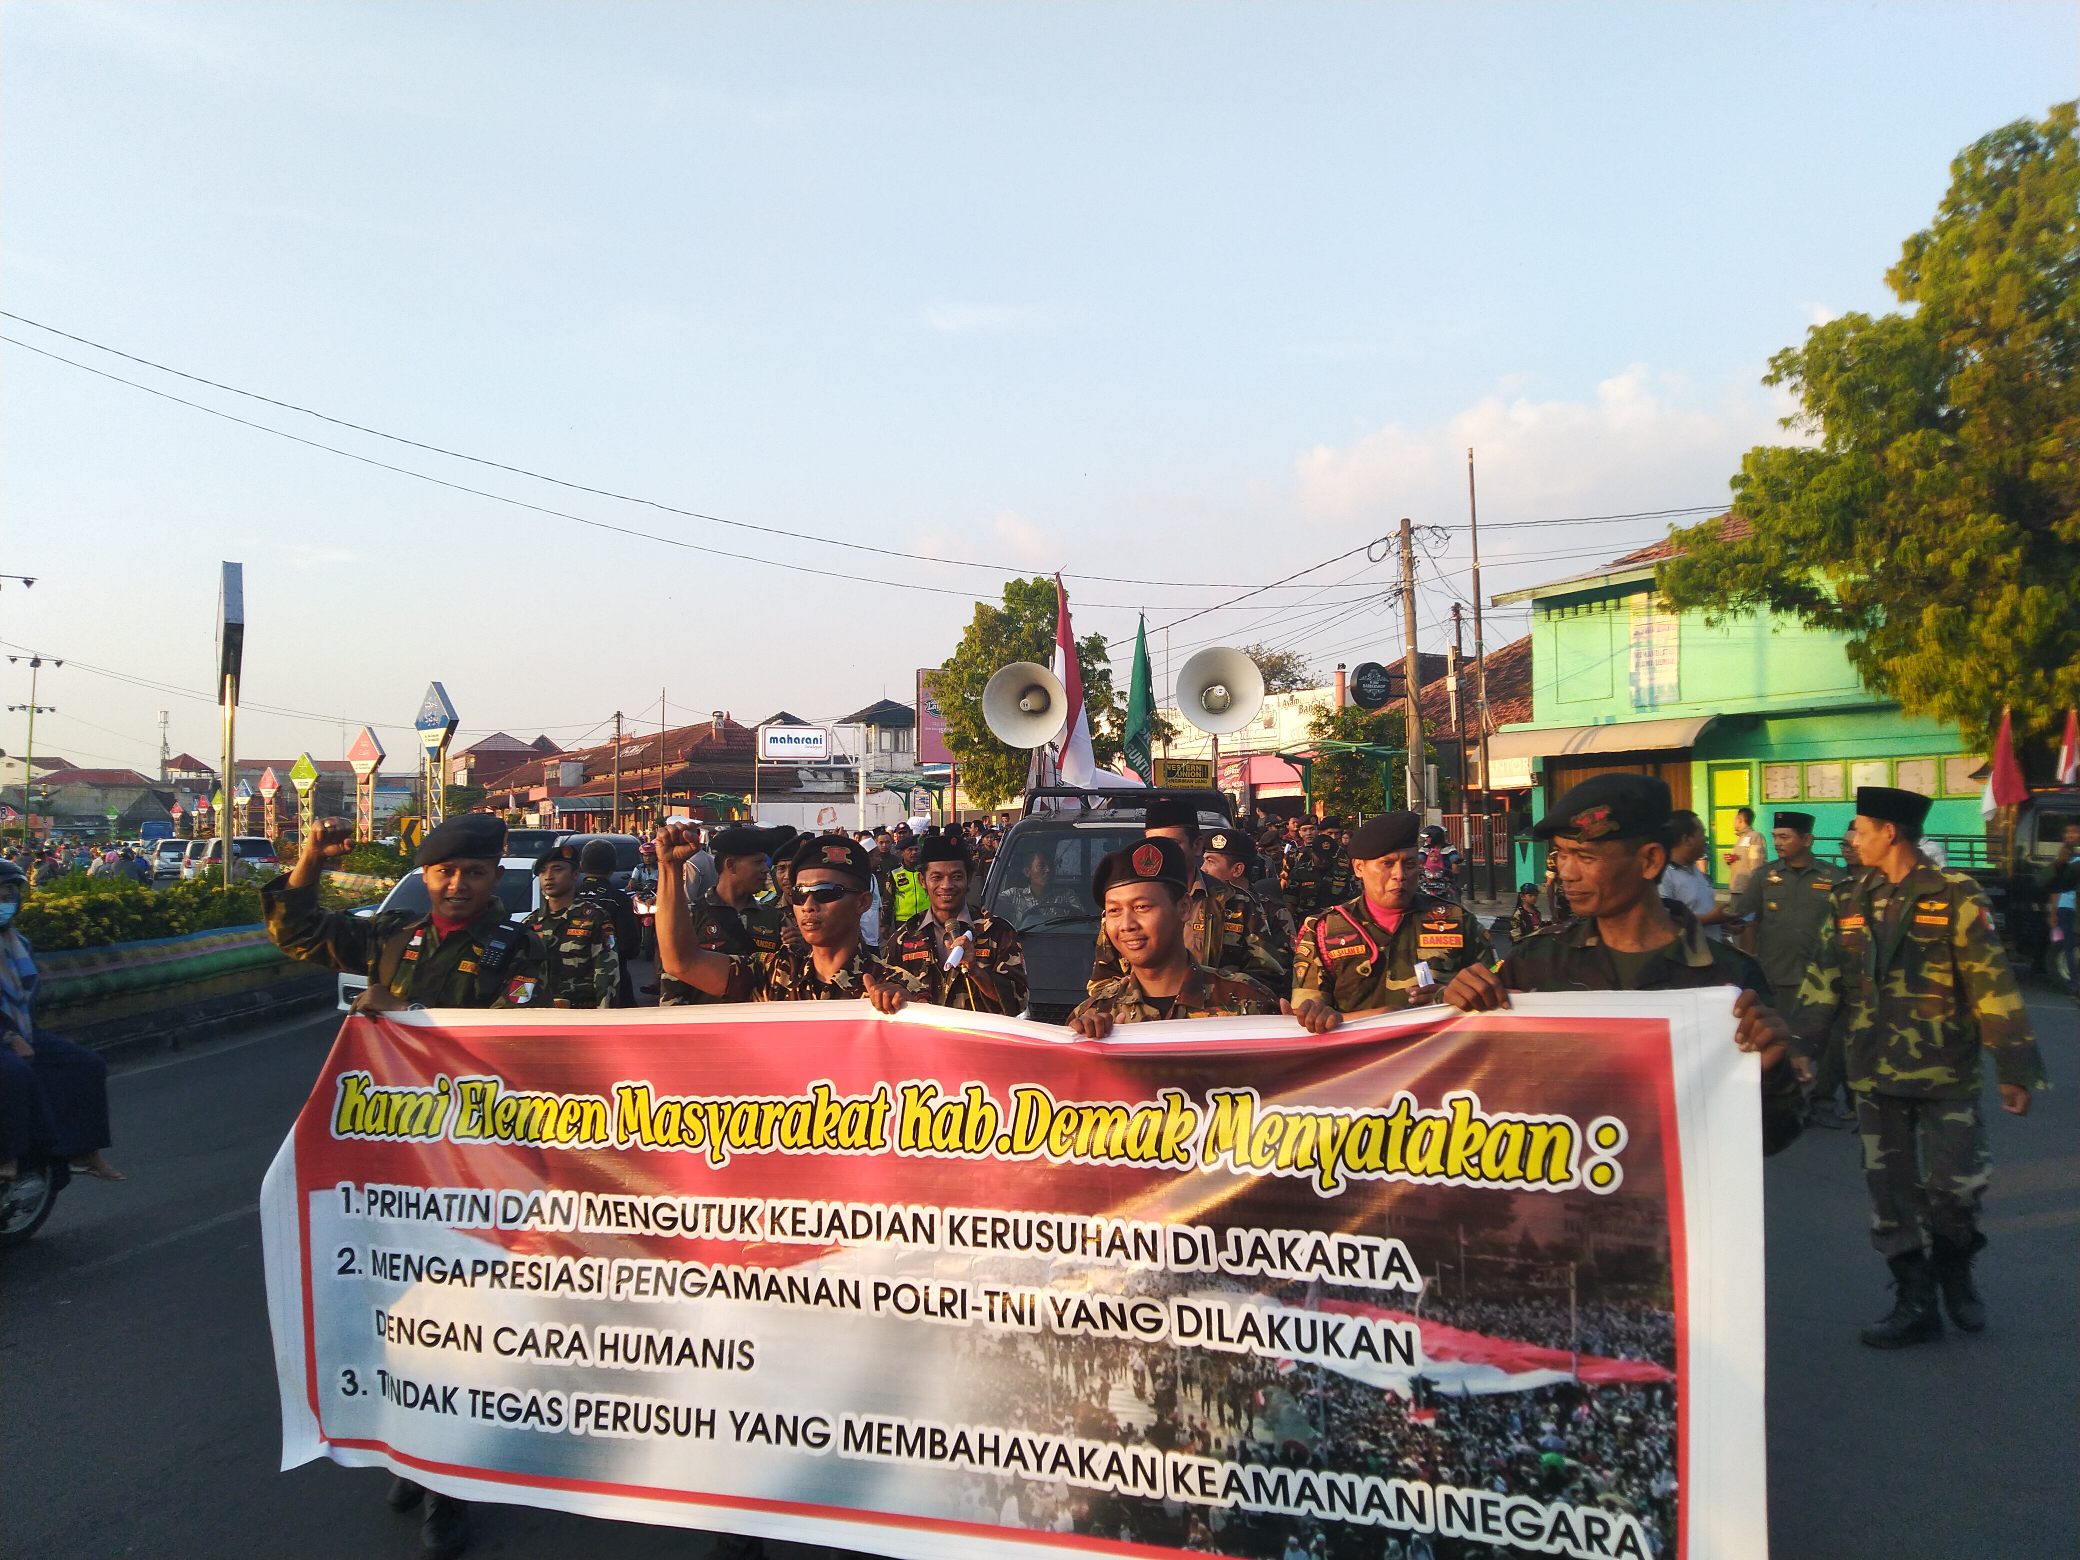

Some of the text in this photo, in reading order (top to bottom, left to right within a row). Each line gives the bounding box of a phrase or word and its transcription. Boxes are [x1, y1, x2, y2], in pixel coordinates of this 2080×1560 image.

[769, 734, 823, 745] maharani
[1282, 698, 1300, 708] Ayam
[1422, 935, 1462, 946] BANSER
[336, 1075, 450, 1137] Kami
[453, 1079, 608, 1144] Elemen
[616, 1084, 890, 1164] Masyarakat
[1202, 1092, 1575, 1190] Menyatakan
[341, 1186, 1414, 1284] 1. PRIHATIN DAN MENGUTUK KEJADIAN KERUSUHAN DI JAKARTA
[337, 1247, 1414, 1367] 2. MENGAPRESIASI PENGAMANAN POLRI-TNI YANG DILAKUKAN
[376, 1309, 755, 1372] DENGAN CARA HUMANIS
[341, 1369, 1647, 1560] 3. TINDAK TEGAS PERUSUH YANG MEMBAHAYAKAN KEAMANAN NEGARA
